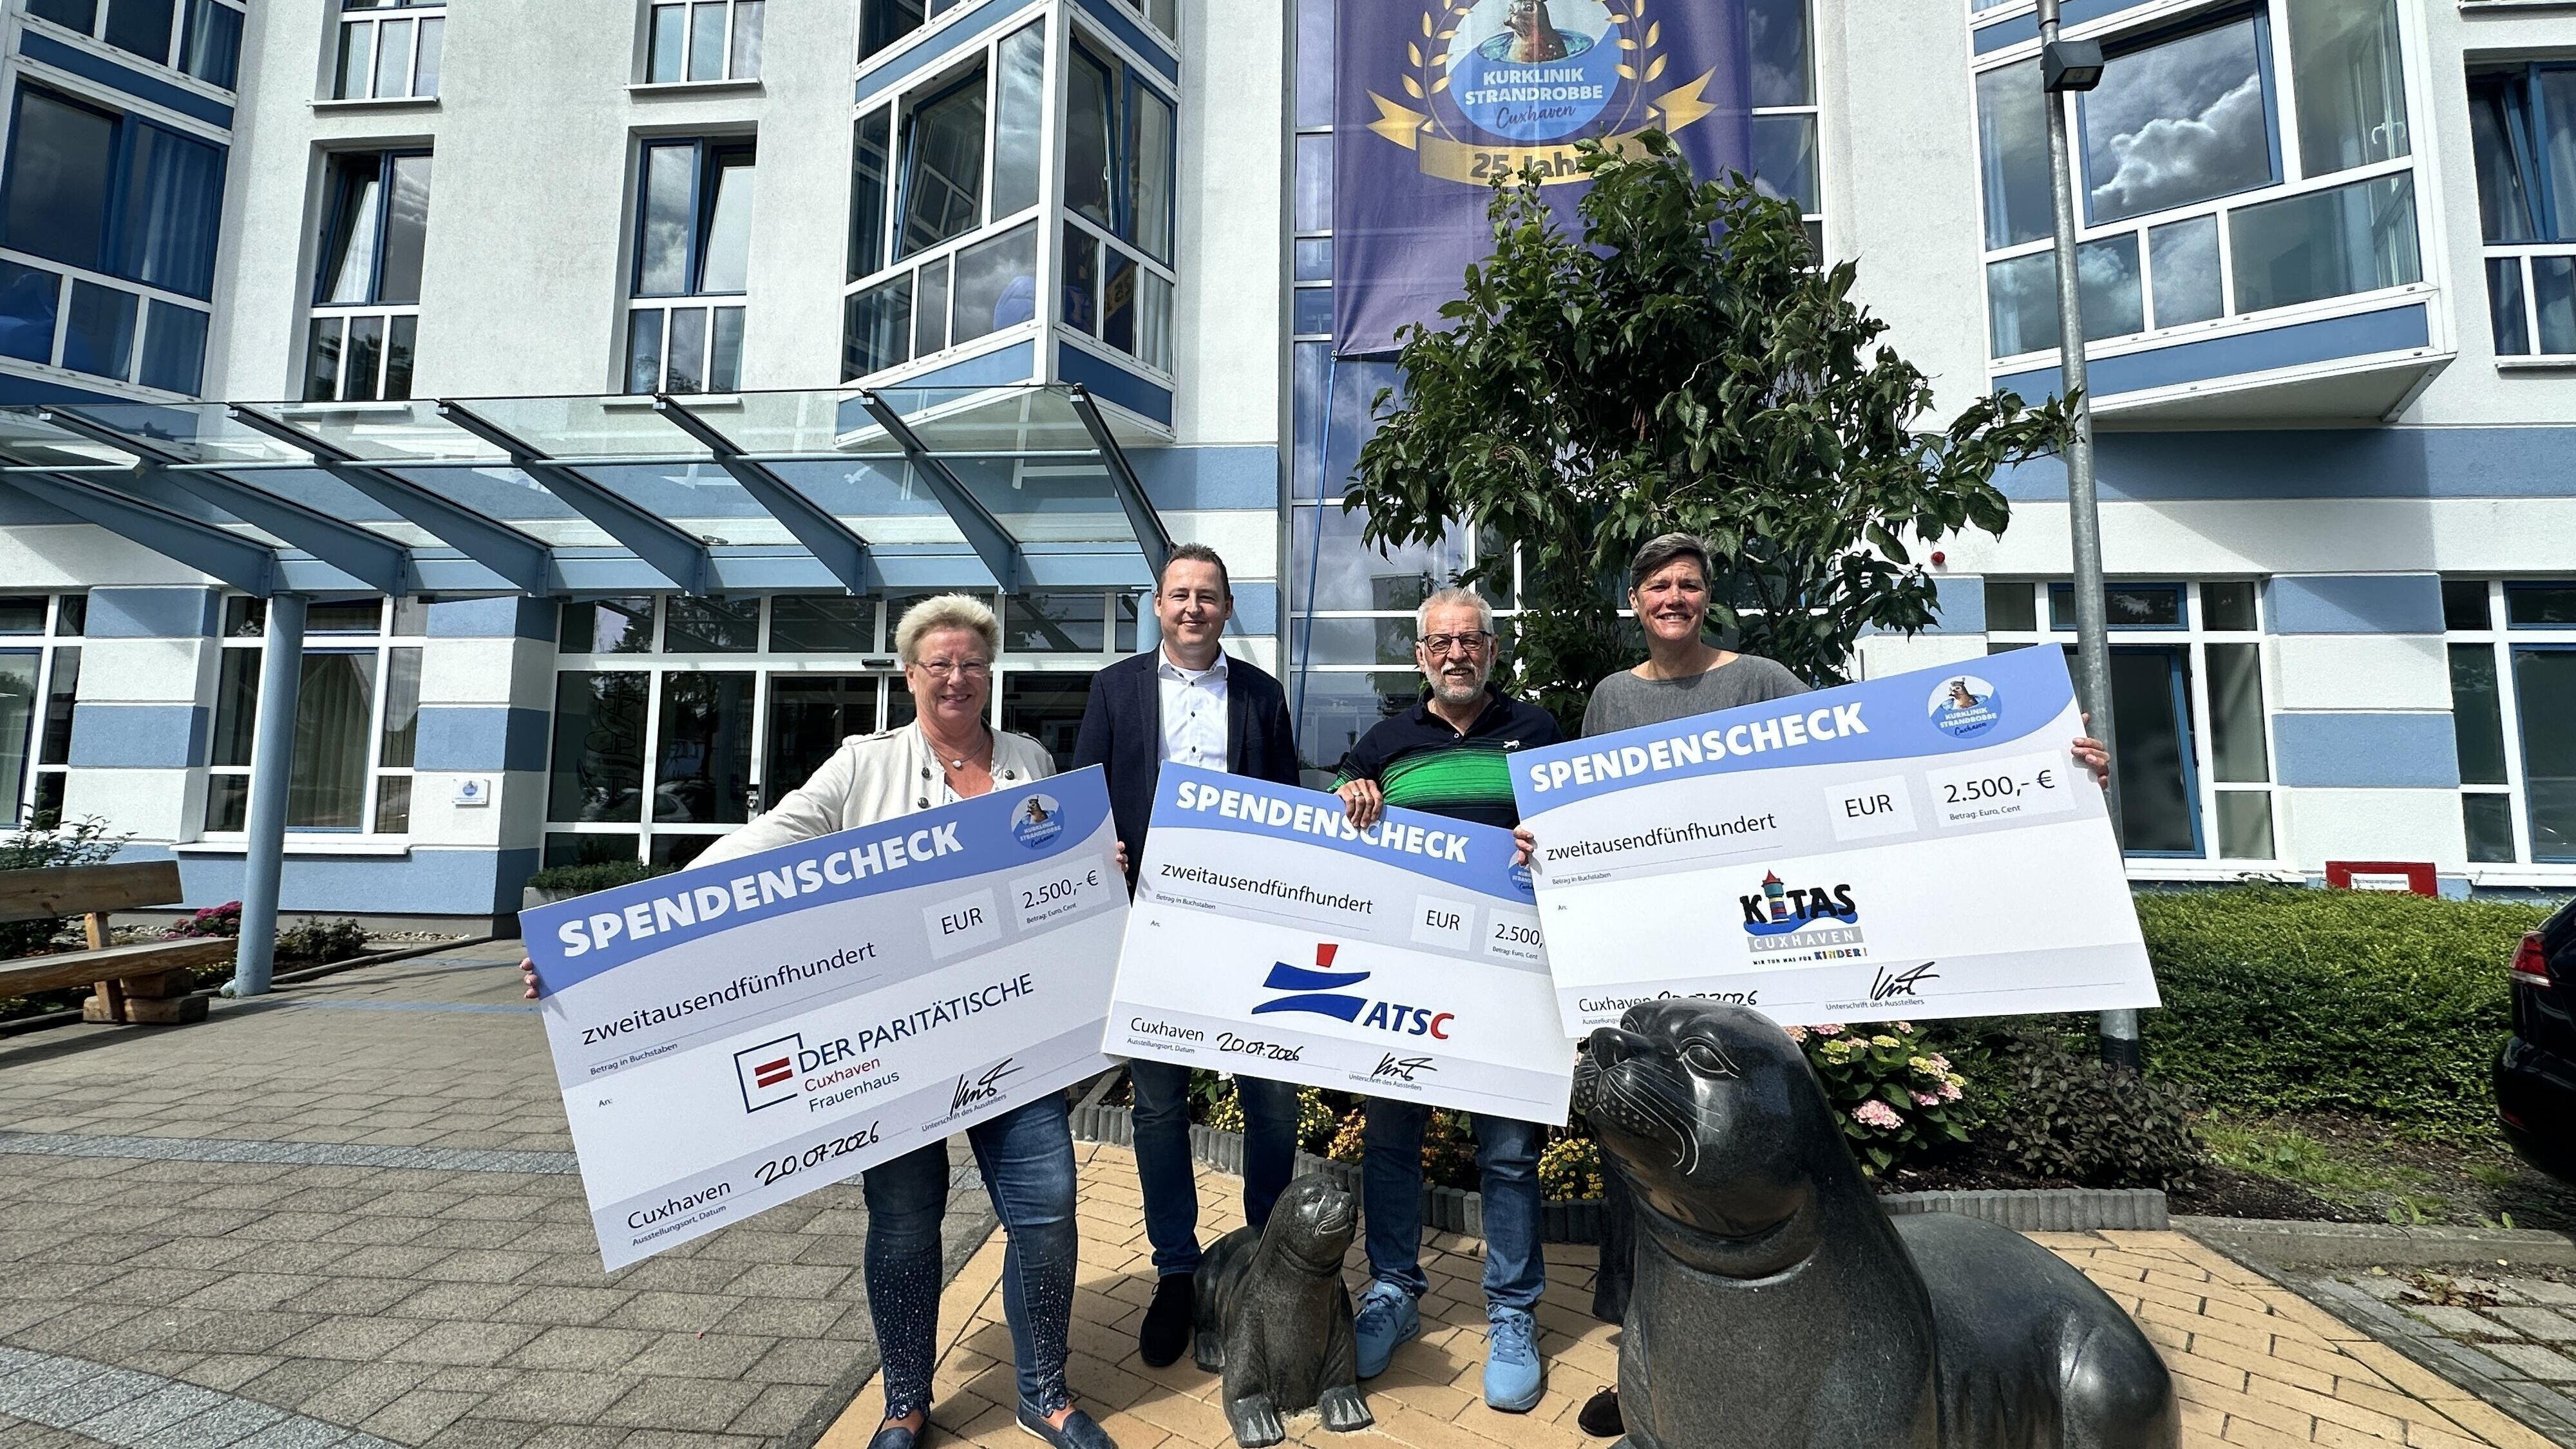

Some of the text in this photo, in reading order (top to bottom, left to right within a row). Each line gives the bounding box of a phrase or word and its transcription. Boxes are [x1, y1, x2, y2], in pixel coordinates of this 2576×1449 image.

[1483, 68, 1584, 86] KURKLINIK
[1464, 85, 1603, 105] STRANDROBBE
[1496, 105, 1577, 129] Cuxhaven
[1470, 153, 1509, 178] 25
[1940, 713, 1998, 728] STRANDROBBE
[1946, 707, 1988, 720] KURKLINIK
[1530, 702, 1870, 792] SPENDENSCHECK
[1944, 770, 2055, 803] 2.500,- €
[1845, 794, 1893, 817] EUR
[1949, 805, 2022, 820] Betrag: Euro, Cent
[1176, 781, 1470, 864] SPENDENSCHECK
[1547, 813, 1777, 861] zweitausendfünfhundert
[558, 820, 963, 957] SPENDENSCHECK
[1022, 870, 1099, 909] 2.500,- €
[1161, 864, 1373, 914] zweitausendfünfhundert
[941, 907, 983, 934] EUR
[1063, 903, 1077, 911] Cent
[1426, 909, 1460, 931] EUR
[1754, 929, 1854, 950] CUXHAVEN
[582, 942, 876, 1045] zweitausendfünfhundert
[1826, 1001, 1868, 1010] Unterschrift
[1884, 999, 1925, 1007] Ausstellers
[798, 973, 1034, 1074] DER PARITÄTISCHE
[1131, 1017, 1204, 1041] Cuxhaven
[1362, 1001, 1455, 1040] ATSC
[590, 1062, 618, 1075] Betrag
[629, 1043, 678, 1063] Buchstaben
[1175, 1045, 1195, 1054] Datum
[1216, 1032, 1304, 1061] 20.07.2026
[805, 1058, 881, 1092] Cuxhaven
[598, 1097, 612, 1107] An:
[809, 1072, 900, 1112] Frauenhaus
[961, 1108, 973, 1116] des
[974, 1094, 1007, 1112] Ausstellers
[754, 1121, 880, 1186] 20.07.2026
[627, 1182, 731, 1229] Cuxhaven
[632, 1205, 726, 1246] Ausstellungsort, Datum
